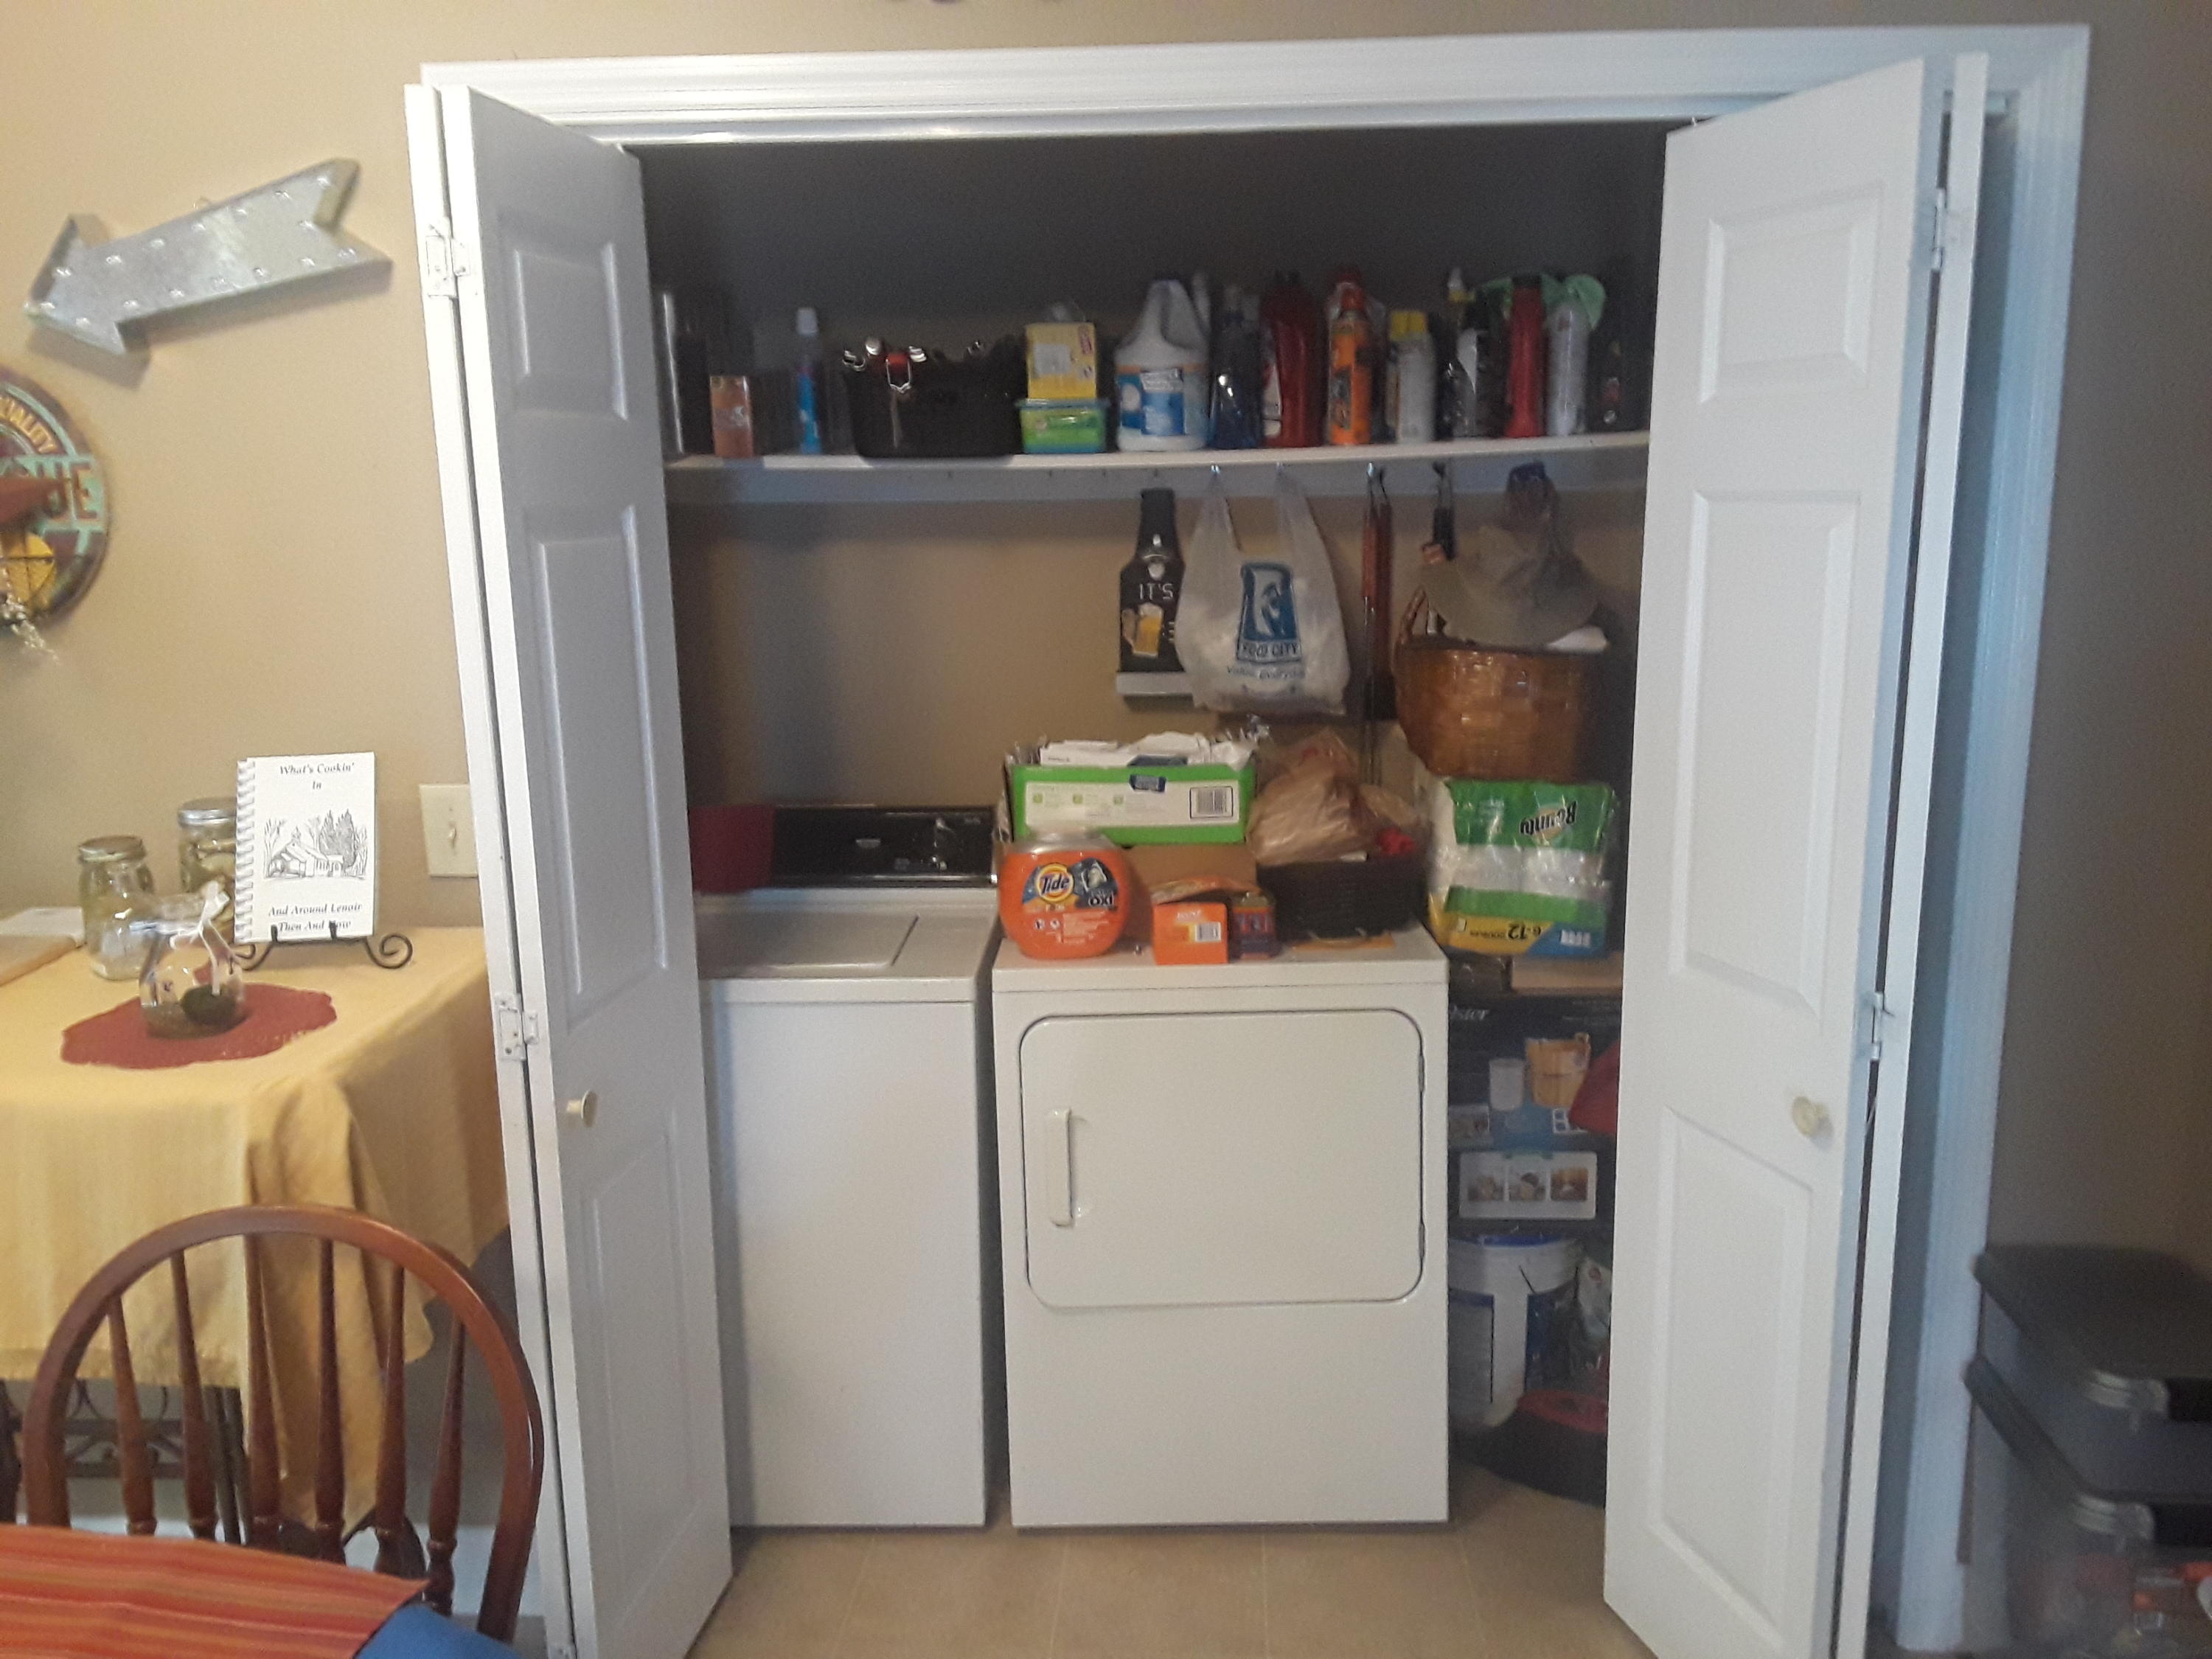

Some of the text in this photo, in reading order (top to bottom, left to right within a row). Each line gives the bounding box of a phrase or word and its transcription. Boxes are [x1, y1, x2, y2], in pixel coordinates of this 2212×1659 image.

[1139, 582, 1173, 600] IT'S
[1272, 642, 1298, 655] CITY
[279, 762, 354, 774] What's Cookin'
[313, 781, 321, 790] In
[1519, 801, 1579, 836] Bounty
[1040, 873, 1070, 894] Tide
[268, 902, 362, 917] And Around Lenoir
[279, 921, 301, 932] Then
[305, 919, 324, 931] And
